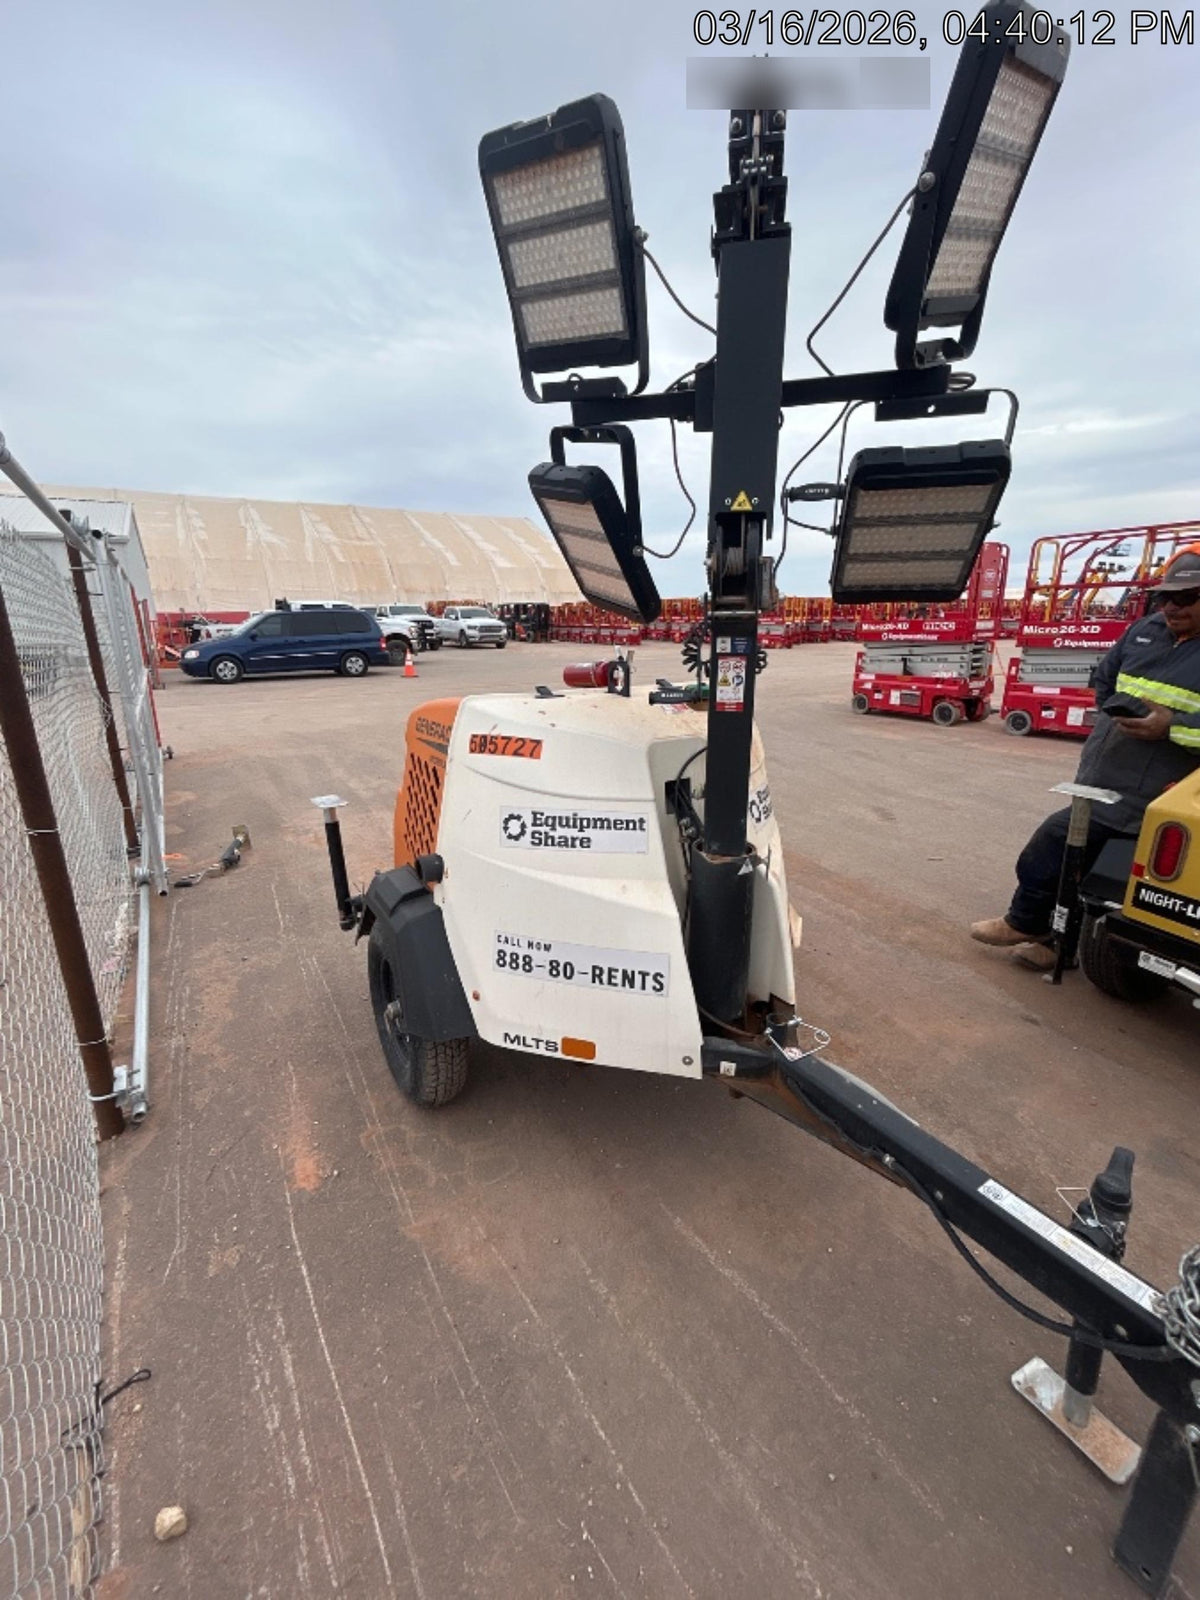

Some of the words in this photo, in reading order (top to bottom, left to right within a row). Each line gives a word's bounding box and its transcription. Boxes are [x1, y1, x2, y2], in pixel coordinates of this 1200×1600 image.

[530, 810, 647, 833] Equipment
[530, 829, 592, 849] Share
[497, 934, 522, 948] CALL
[527, 939, 552, 952] NOW
[496, 949, 665, 993] 888-80-RENTS
[503, 1032, 559, 1052] MLTS
